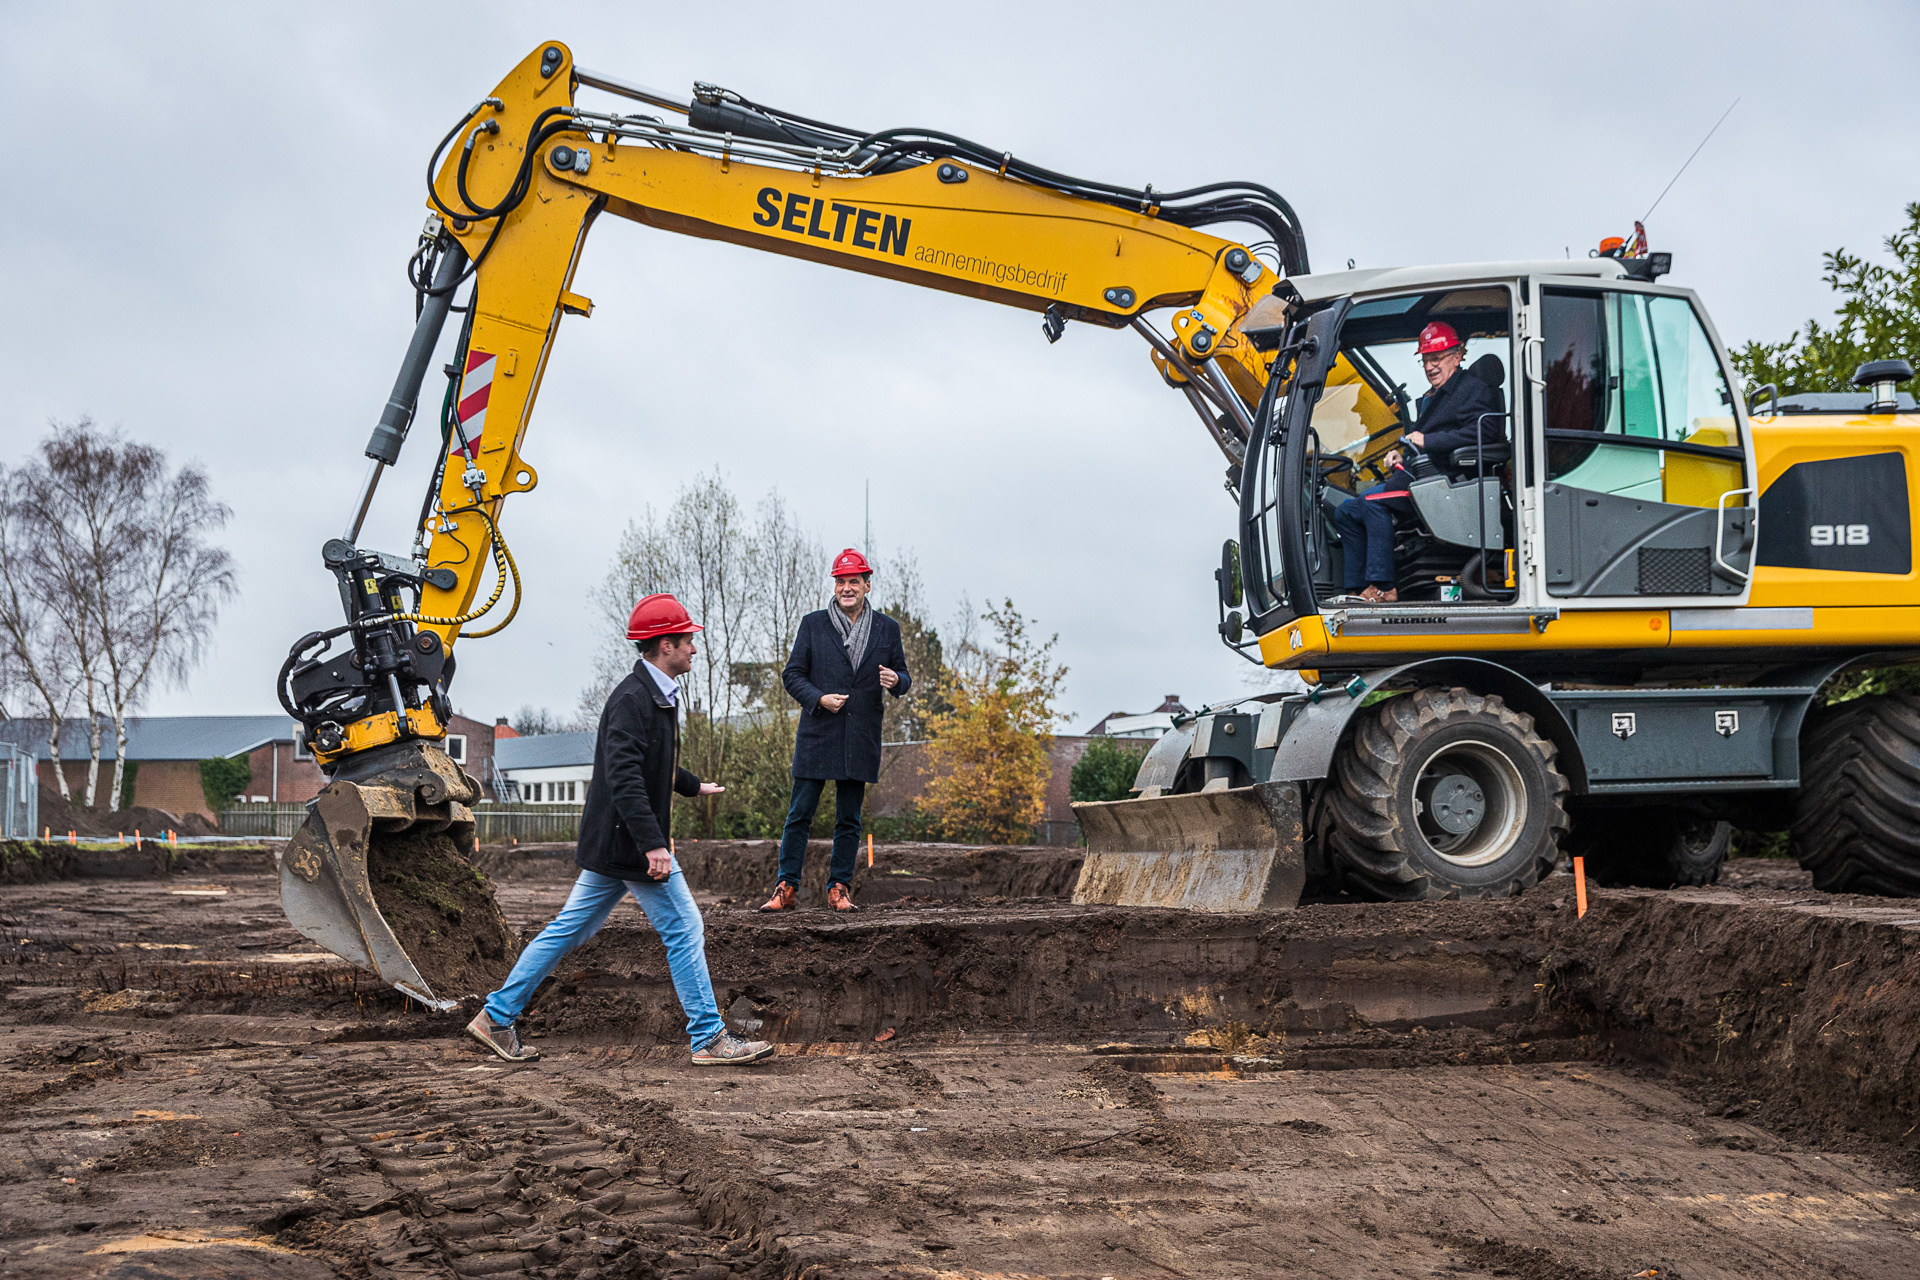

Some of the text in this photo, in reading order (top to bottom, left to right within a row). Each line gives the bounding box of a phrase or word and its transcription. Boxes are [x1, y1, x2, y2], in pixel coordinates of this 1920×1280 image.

[753, 187, 912, 257] SELTEN
[914, 245, 1068, 295] aannemingsbedrijf
[1810, 524, 1870, 546] 918
